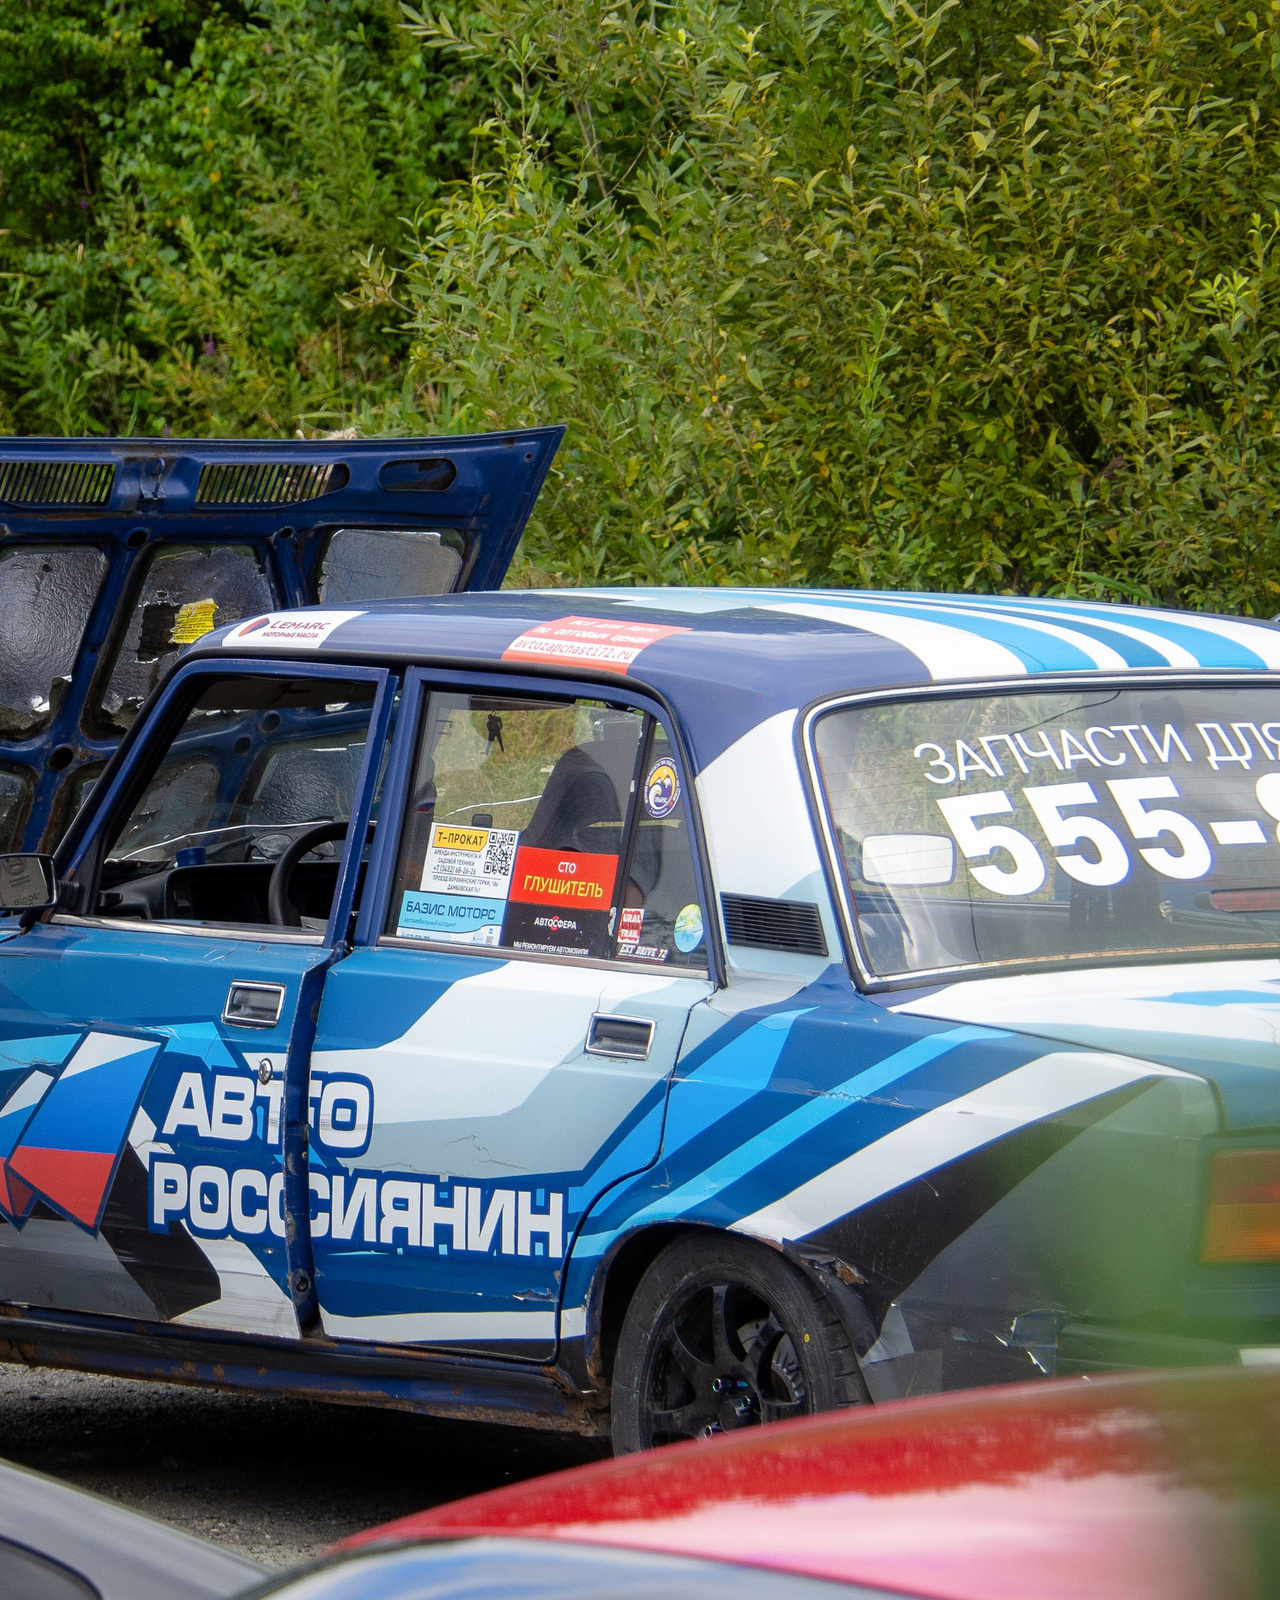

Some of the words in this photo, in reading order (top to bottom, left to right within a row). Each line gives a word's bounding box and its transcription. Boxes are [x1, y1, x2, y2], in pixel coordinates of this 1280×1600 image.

[269, 620, 332, 630] LEMARC
[514, 638, 634, 660] avtozapchasti72.ru
[913, 723, 1193, 785] ЗАПЧАСТИ
[439, 832, 484, 846] Т-ПРОКАТ
[450, 850, 478, 858] ИНСТРУМЕНТА
[557, 861, 577, 874] СТО
[432, 874, 448, 882] ПРОЕЗД
[523, 875, 603, 898] ГЛУШИТЕЛЬ
[406, 901, 445, 916] БАЗИС
[447, 905, 496, 920] МОТОРС
[534, 917, 577, 930] АВТОСФЕРА
[622, 913, 641, 923] URAL
[620, 929, 639, 938] TRAIL
[521, 942, 557, 952] РЕМОНТИРУЕМ
[556, 946, 590, 955] АВТОМОБИЛИ
[635, 946, 658, 957] DRIVE
[658, 949, 668, 958] 72
[162, 1071, 371, 1150] АВТО
[153, 1161, 564, 1259] РОССИЯНИН
